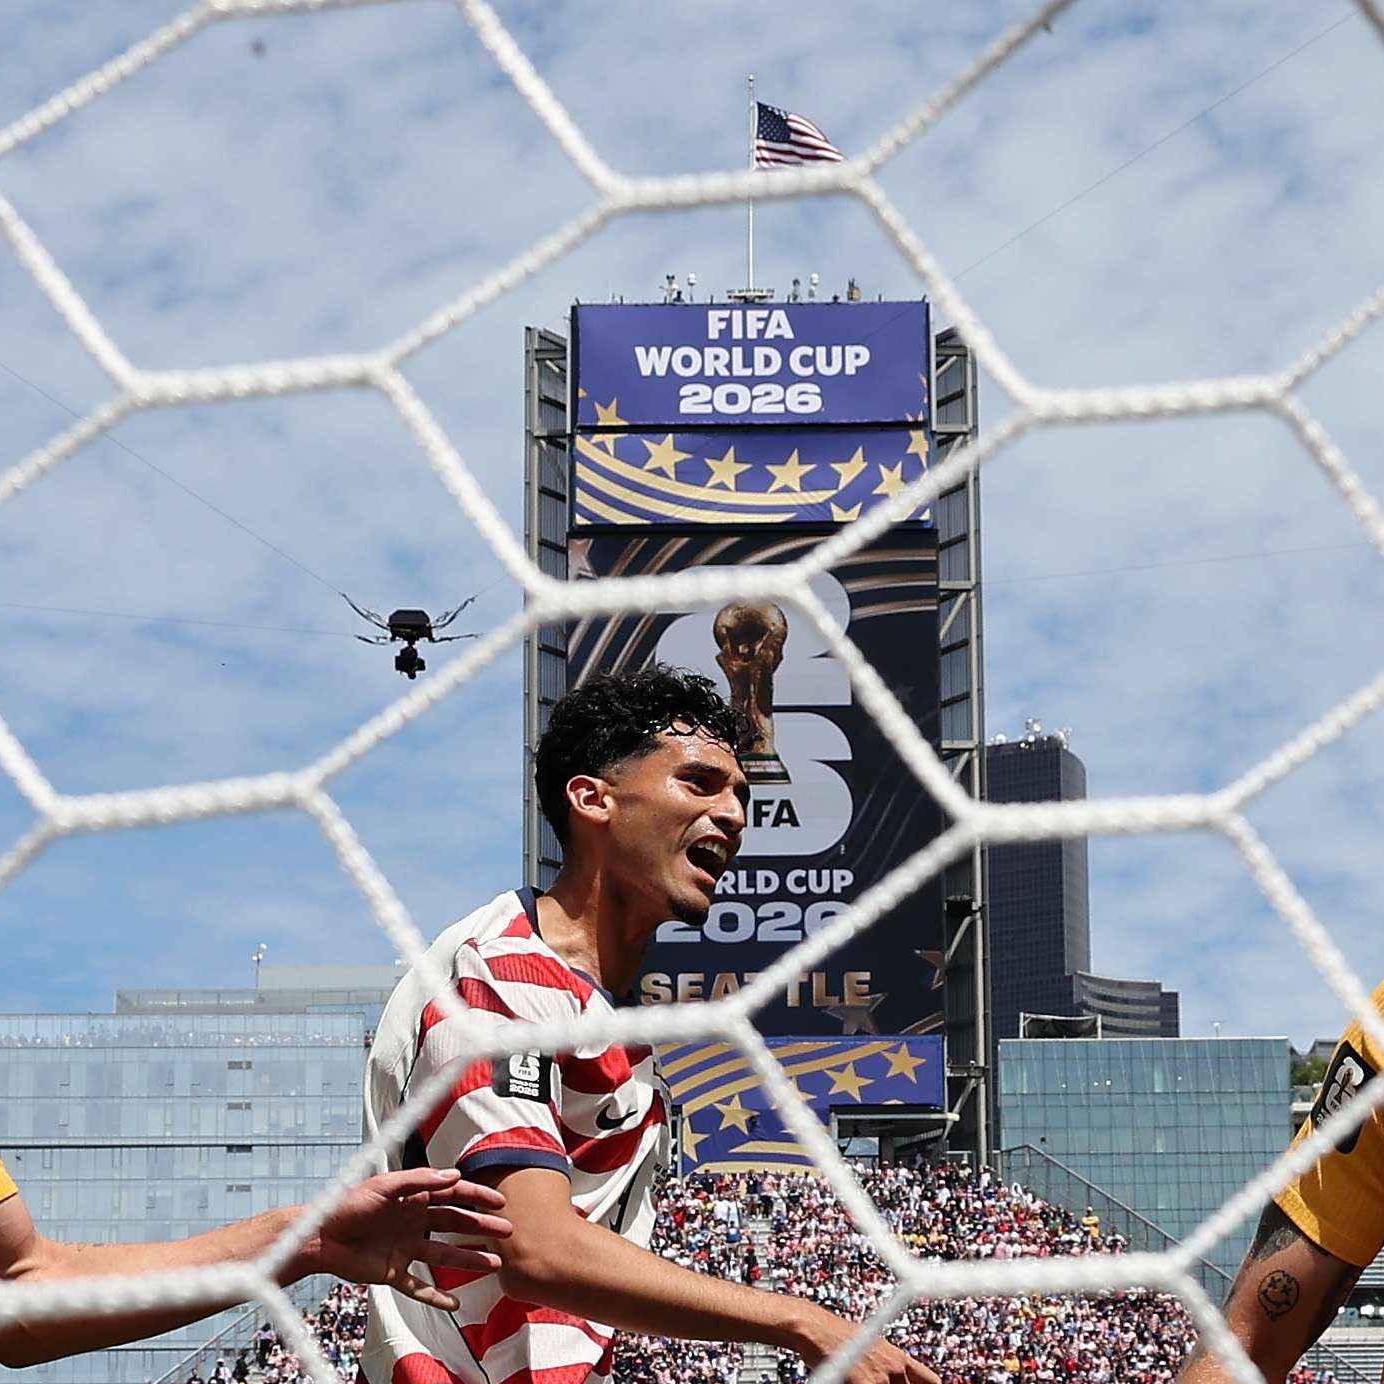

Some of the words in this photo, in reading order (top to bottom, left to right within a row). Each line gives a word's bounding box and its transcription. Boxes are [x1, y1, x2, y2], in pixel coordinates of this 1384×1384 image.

[707, 310, 794, 340] FIFA
[635, 346, 783, 377] WORLD
[789, 345, 871, 377] CUP
[678, 383, 824, 415] 2026
[744, 799, 801, 828] FA
[715, 869, 780, 894] RLD
[786, 869, 854, 894] CUP
